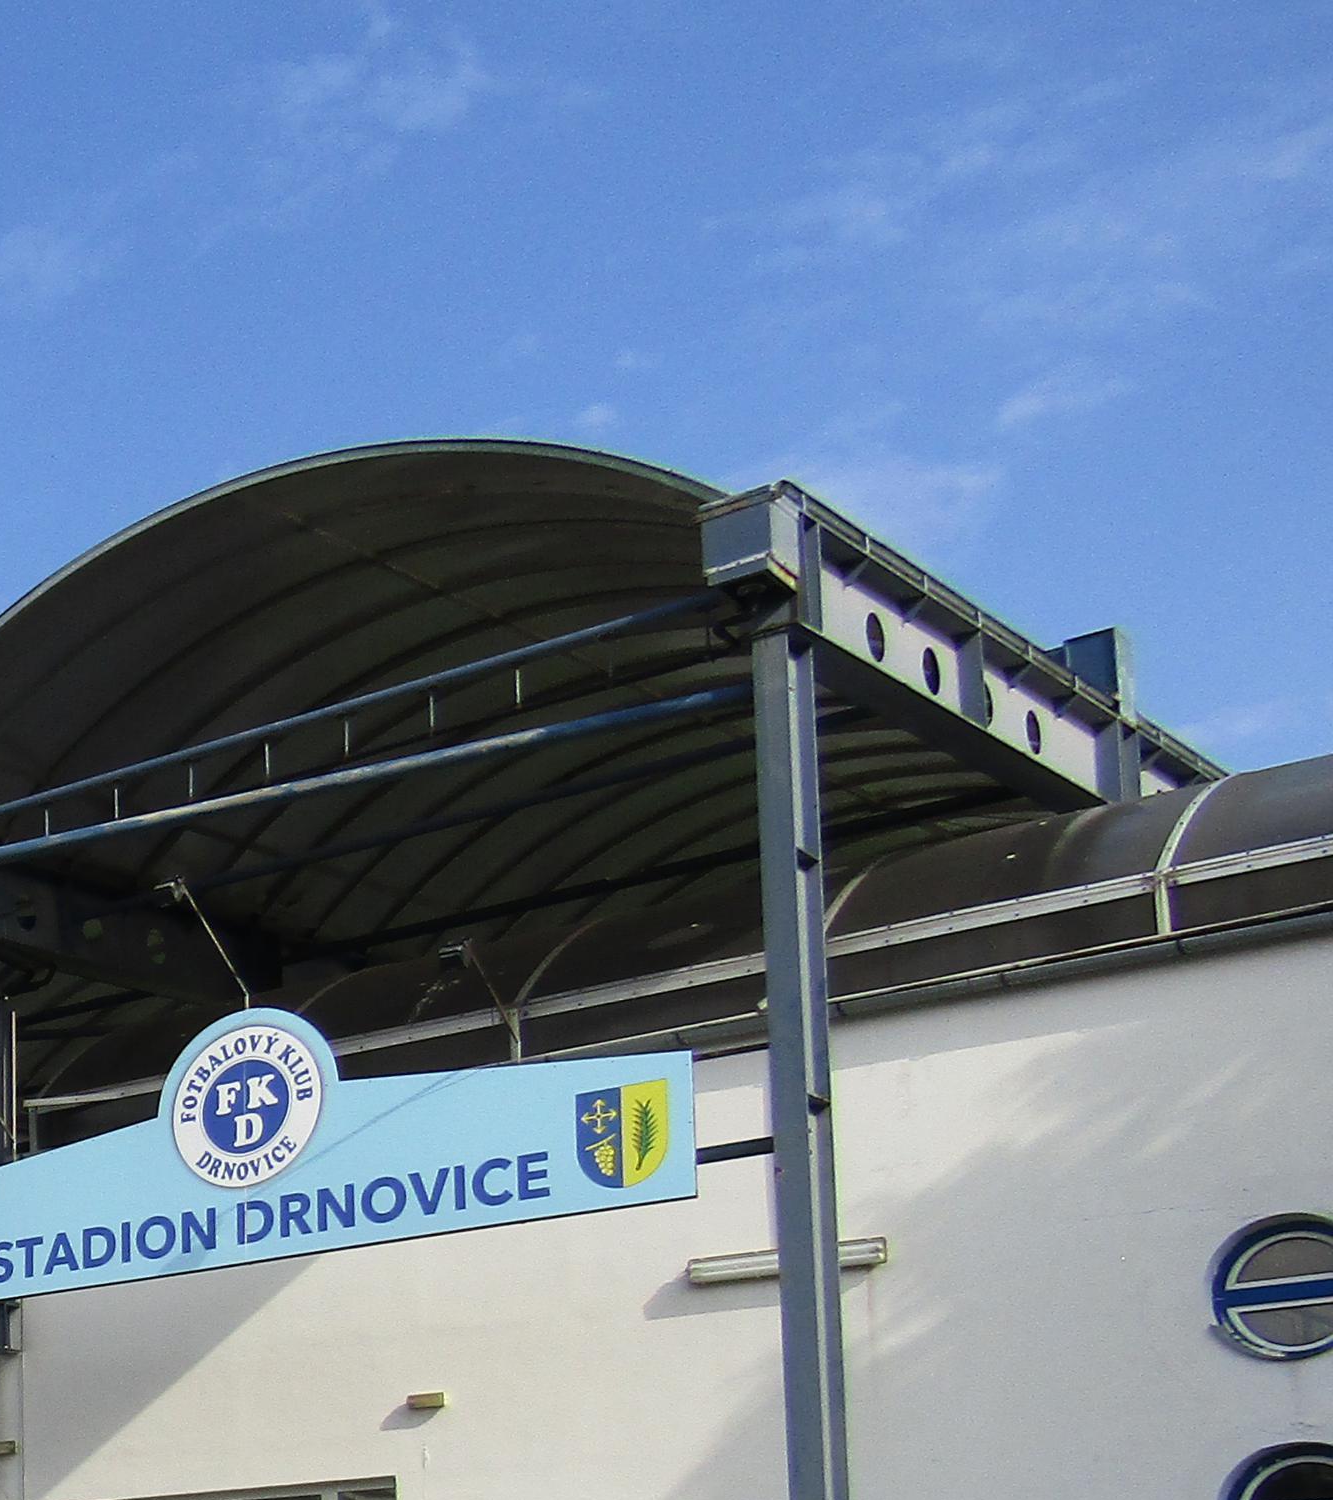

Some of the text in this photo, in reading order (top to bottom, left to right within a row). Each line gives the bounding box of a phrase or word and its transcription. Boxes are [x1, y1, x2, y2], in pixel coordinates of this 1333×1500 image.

[180, 1032, 314, 1124] FOTBALOVÝ KLUB
[215, 1073, 279, 1116] FK
[233, 1112, 264, 1148] D
[195, 1135, 298, 1181] DRNOVICE
[237, 1151, 551, 1246] DRNOVICE
